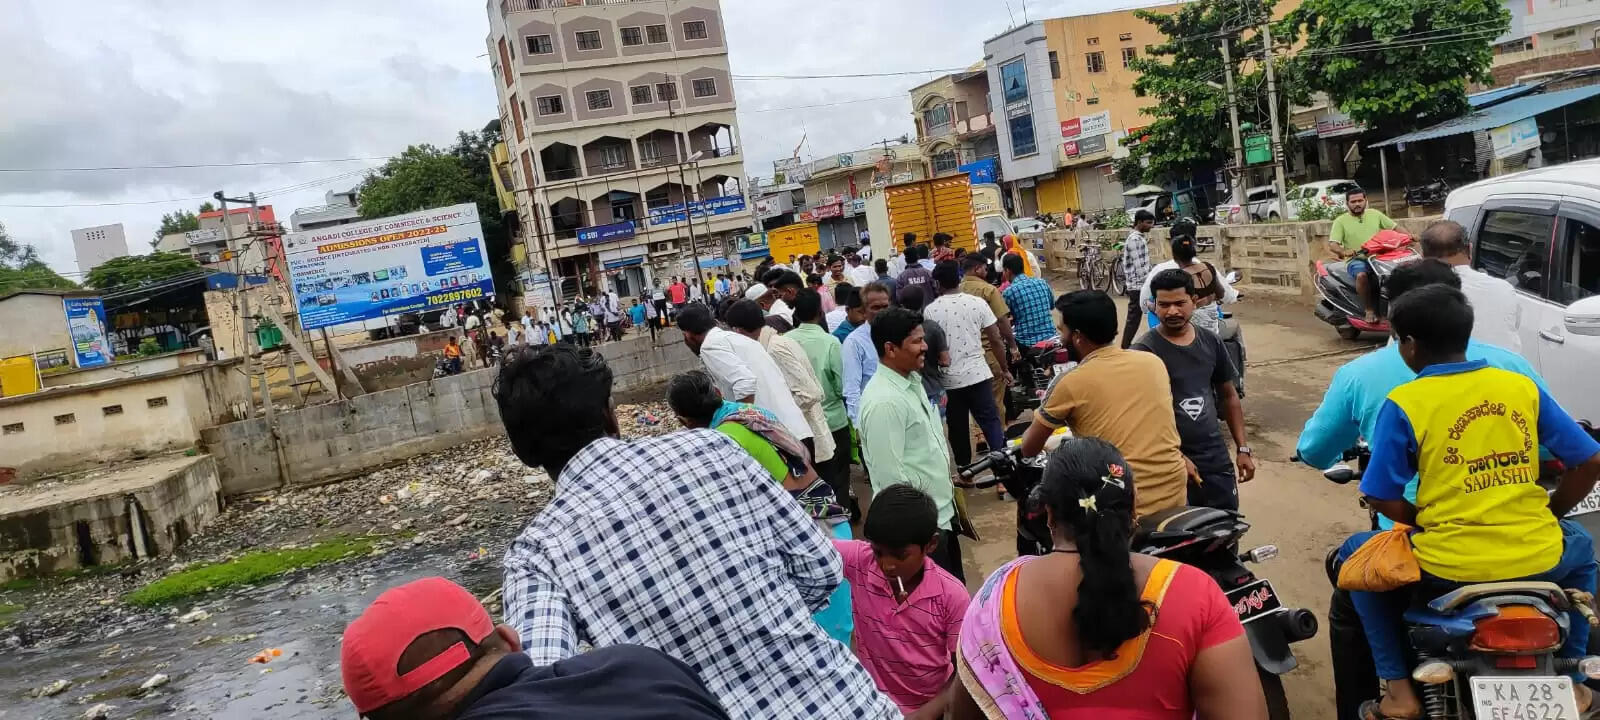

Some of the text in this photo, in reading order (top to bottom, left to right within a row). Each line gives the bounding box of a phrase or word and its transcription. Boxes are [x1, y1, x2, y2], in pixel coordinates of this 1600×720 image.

[312, 232, 340, 242] ANGADI
[341, 227, 373, 238] COLLEGE
[384, 218, 424, 230] COMMERCE
[432, 212, 462, 222] SCIENCE
[587, 231, 598, 240] SBI
[320, 237, 378, 252] ADMISSIONS
[381, 233, 405, 243] OPEN
[426, 287, 483, 306] 7022897602
[1493, 683, 1553, 701] KA 28
